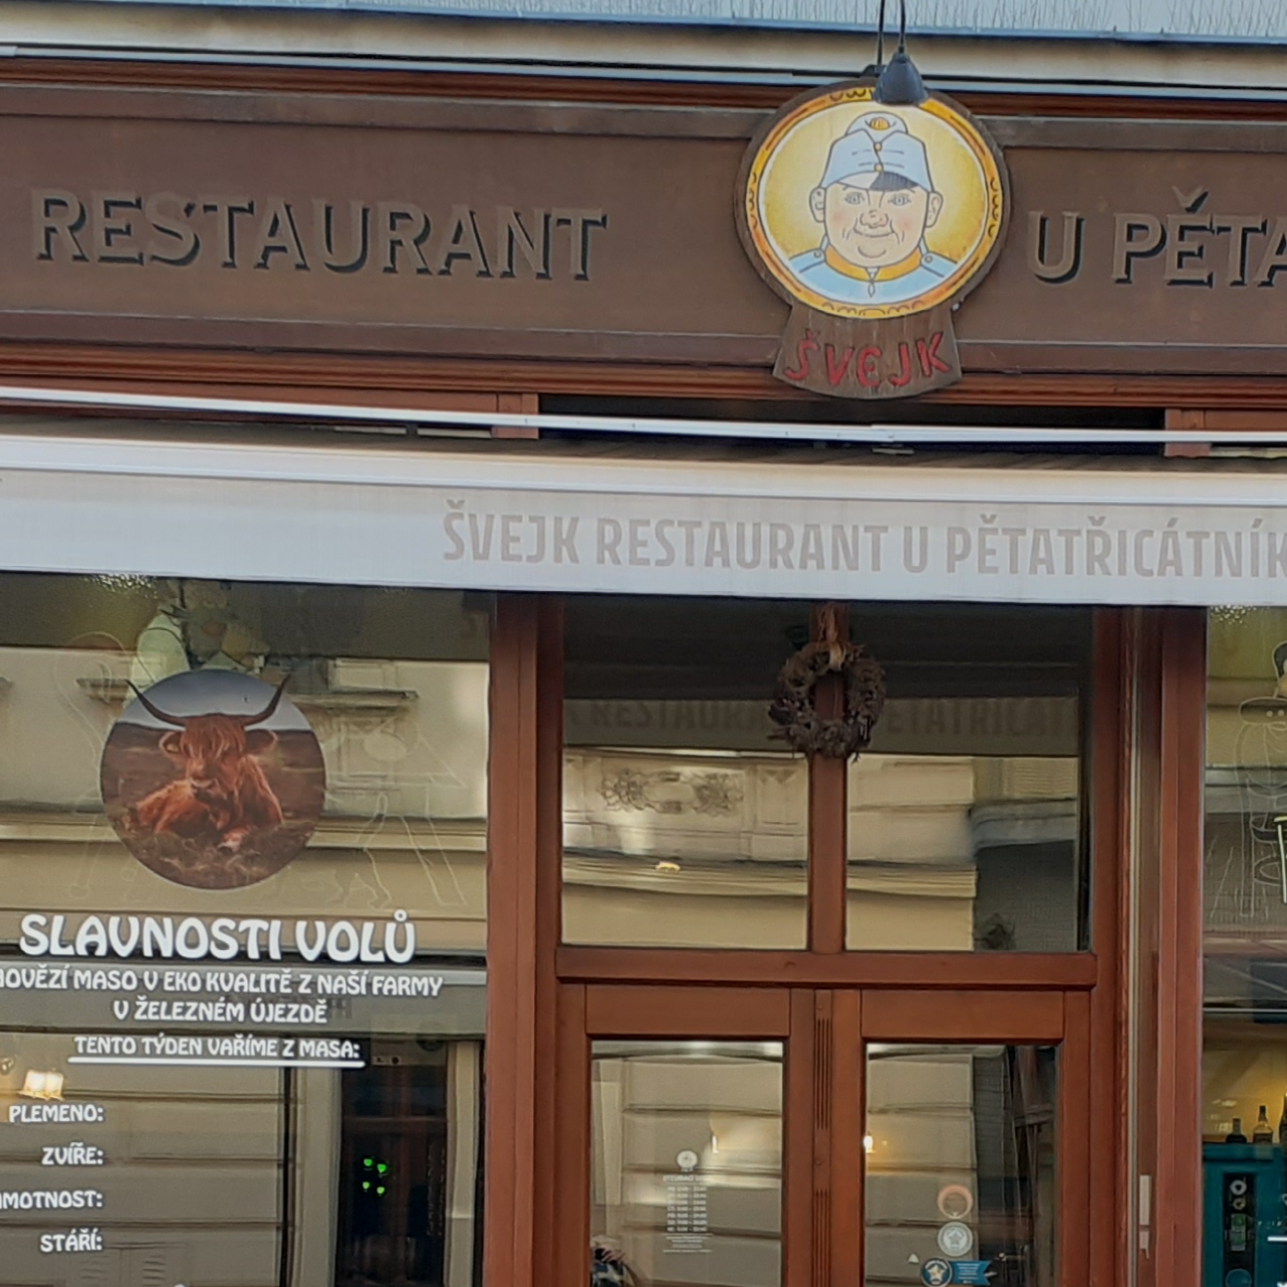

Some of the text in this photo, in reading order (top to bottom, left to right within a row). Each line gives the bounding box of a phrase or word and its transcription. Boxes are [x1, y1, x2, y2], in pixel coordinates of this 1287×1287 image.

[31, 188, 607, 280] RESTAURANT
[1028, 210, 1084, 284] U
[784, 328, 950, 388] ŠVEJK
[442, 498, 580, 564] ŠVEJK
[596, 517, 887, 573] RESTAURANT
[903, 526, 930, 574] U
[20, 909, 415, 964] SLAVNOSTI VOLŮ
[73, 969, 138, 991] MASO
[143, 970, 158, 991] V
[164, 971, 201, 992] EKO
[206, 968, 292, 994] KVALITĚ
[298, 974, 312, 994] Z
[317, 969, 367, 995] NAŠÍ
[371, 975, 443, 996] FARMY
[114, 1000, 129, 1020] V
[134, 995, 244, 1021] ŽELEZNÉM
[250, 998, 328, 1024] ÚJEZDĚ
[74, 1032, 360, 1058] TENTO TÝDEN VAŘÍME Z MASA:
[9, 1104, 103, 1122] PLEMENO:
[41, 1142, 103, 1166] ZVÍŘE:
[40, 1228, 103, 1253] STÁŘÍ:
